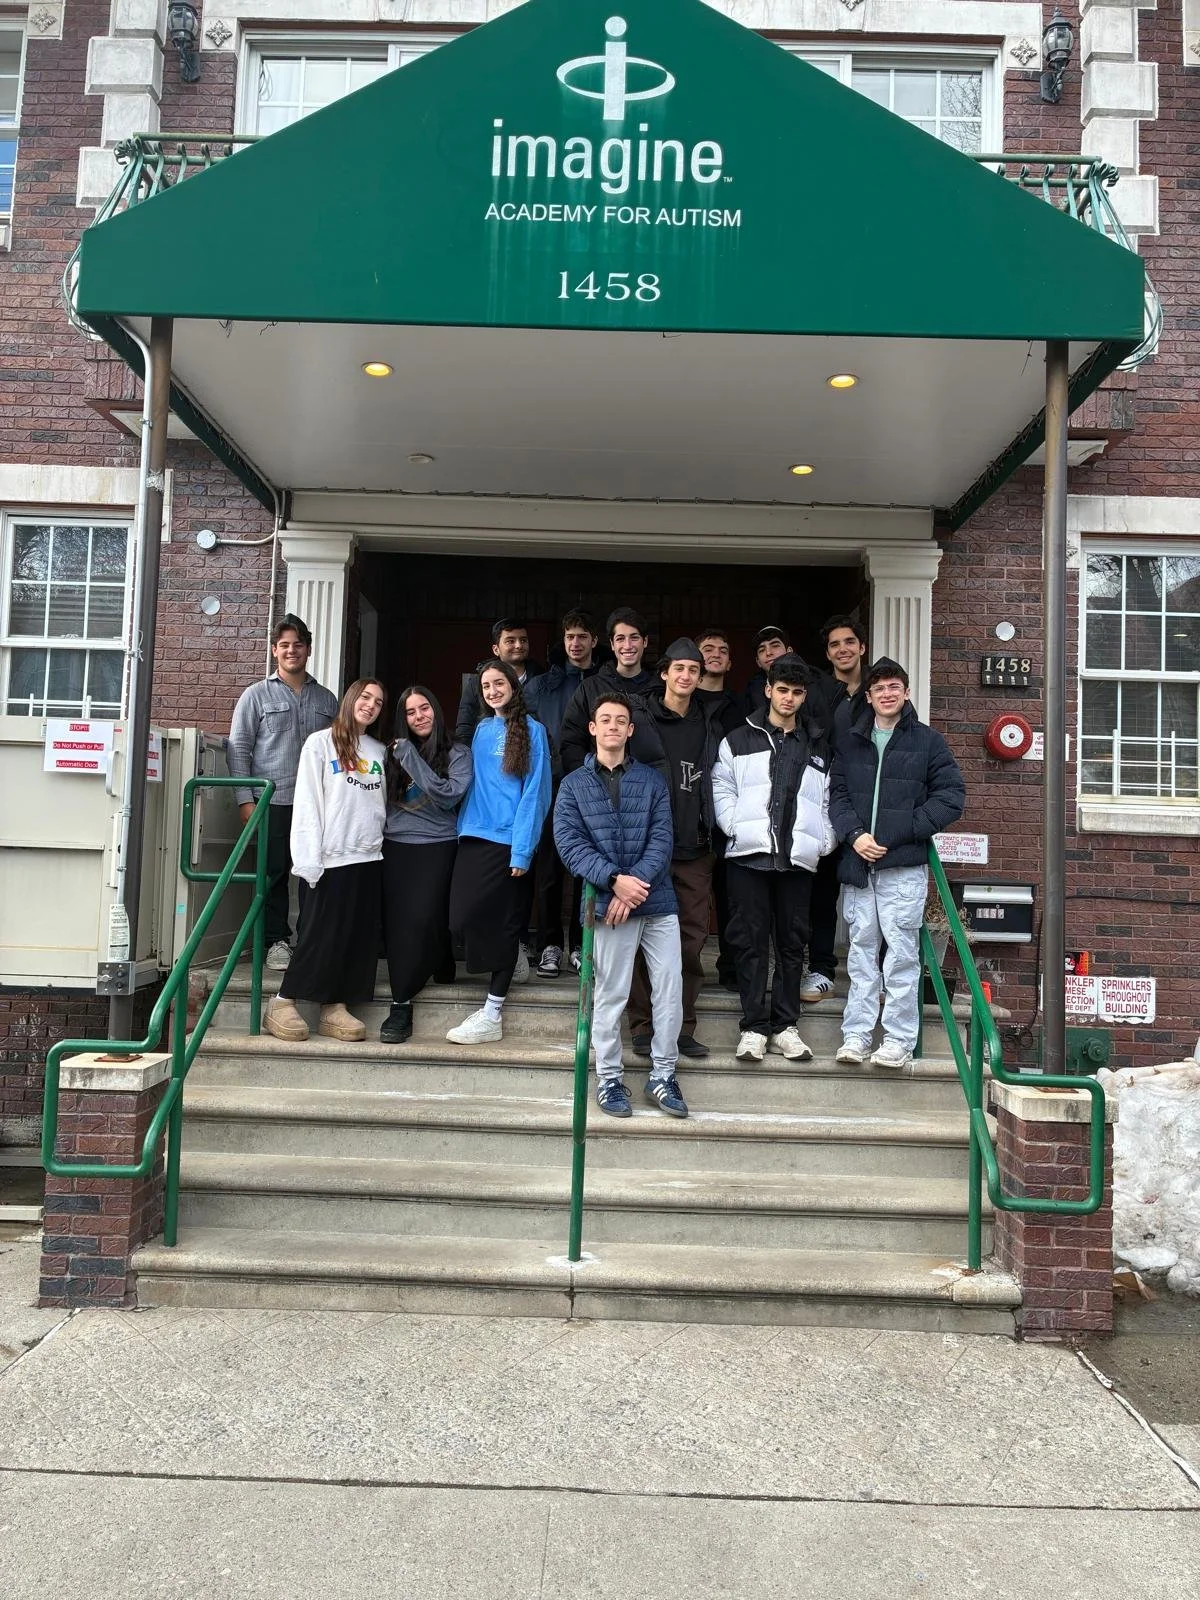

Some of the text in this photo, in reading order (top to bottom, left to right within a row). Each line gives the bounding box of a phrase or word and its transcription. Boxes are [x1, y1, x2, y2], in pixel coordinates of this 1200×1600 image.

[492, 118, 723, 194] imagine
[484, 203, 742, 227] ACADEMY FOR AUTISM
[557, 271, 661, 302] 1458
[984, 657, 1031, 673] 1458
[1065, 977, 1095, 988] NKLER
[1101, 979, 1152, 991] SPRINKLERS
[1065, 987, 1086, 996] MESE
[1101, 991, 1152, 1003] THROUGHOUT
[1066, 996, 1095, 1005] ECTION
[1105, 1003, 1148, 1014] BUILDING
